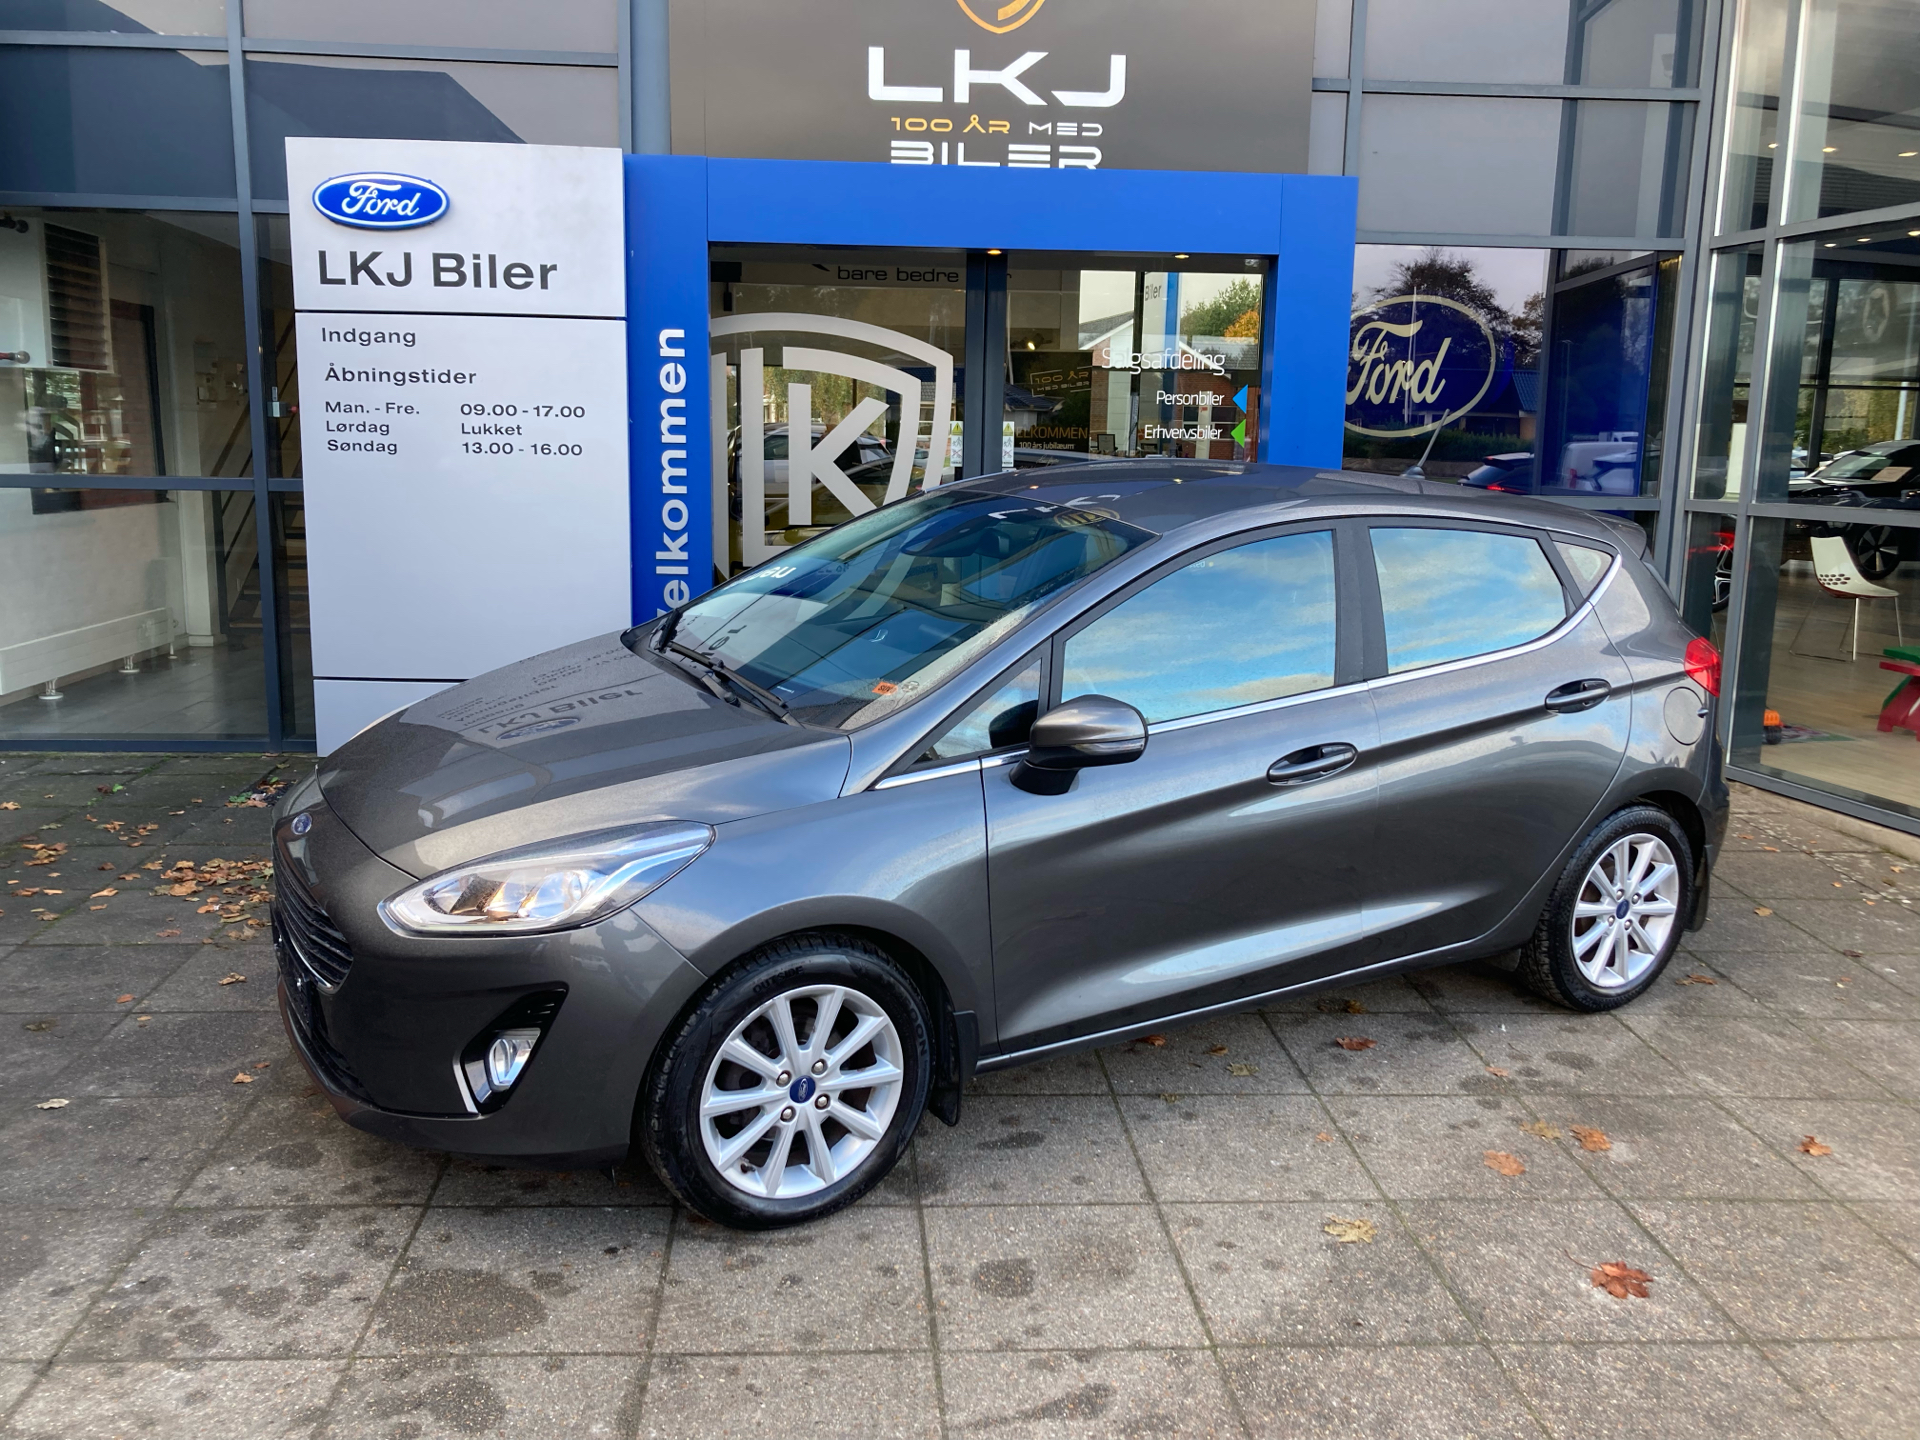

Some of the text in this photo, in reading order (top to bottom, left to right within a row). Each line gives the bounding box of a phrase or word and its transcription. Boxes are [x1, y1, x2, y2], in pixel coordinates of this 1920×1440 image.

[868, 46, 1127, 107] LKJ
[890, 114, 1103, 137] 100 ÅR MED
[890, 140, 1103, 170] BILER
[341, 181, 423, 217] Ford
[317, 250, 558, 290] LKJ Biler
[837, 265, 959, 283] bare bedre
[321, 327, 417, 347] Indgang
[1101, 348, 1227, 376] Salgsafdeling
[1346, 319, 1452, 406] Ford
[325, 362, 477, 386] Åbningstider
[1034, 375, 1064, 385] 100
[1155, 390, 1225, 406] Personbiler
[325, 401, 371, 414] Man.
[385, 402, 421, 415] Fre.
[460, 404, 518, 417] 09.00
[533, 405, 586, 419] 17.00
[326, 420, 390, 436] Lørdag
[461, 423, 523, 437] Lukket
[1014, 426, 1089, 440] ELKOMMEN
[1144, 424, 1223, 440] Erhvervsbiler
[327, 439, 398, 455] Søndag
[461, 442, 514, 455] 13.00
[530, 443, 583, 456] 16.00
[655, 328, 691, 618] elkommen
